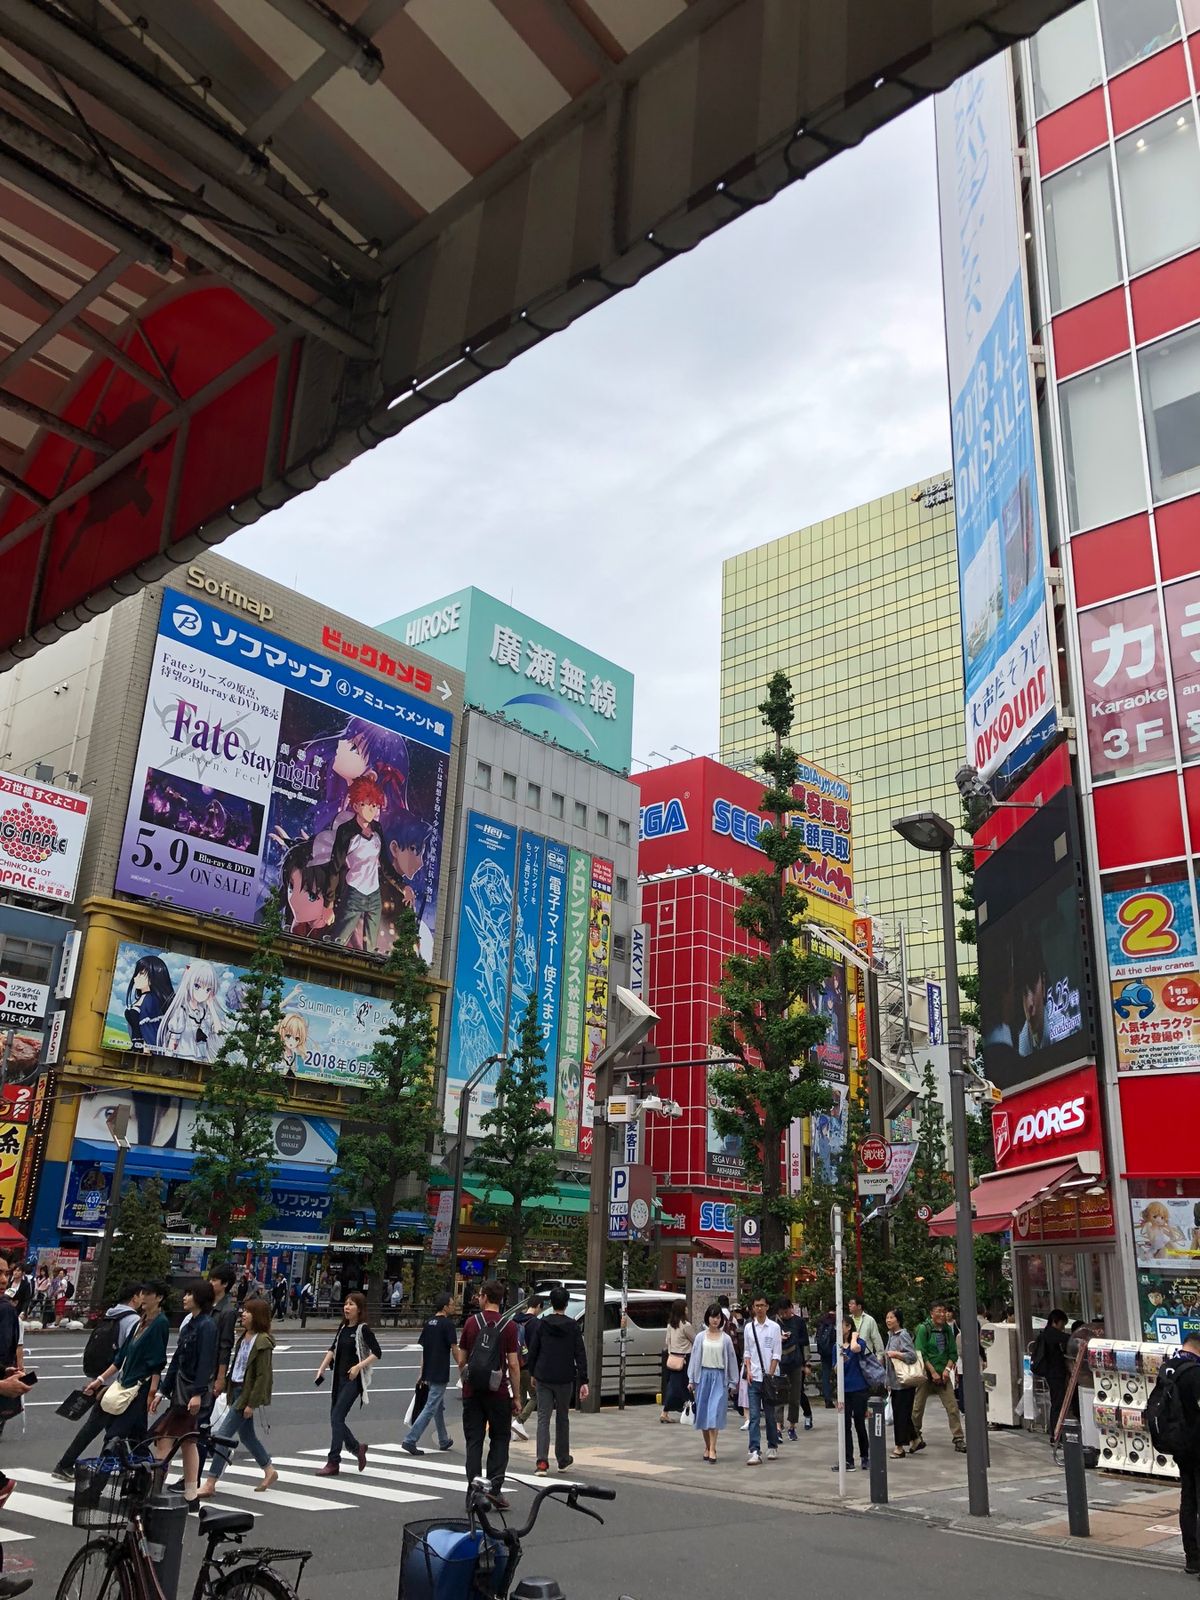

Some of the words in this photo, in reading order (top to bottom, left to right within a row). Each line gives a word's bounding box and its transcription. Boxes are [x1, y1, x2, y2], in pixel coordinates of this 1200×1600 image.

[958, 445, 980, 519] ON
[980, 355, 1026, 474] SALE
[186, 565, 274, 622] Sofmap
[405, 601, 462, 647] HIROSE
[210, 621, 332, 688] ソフマップ
[322, 625, 433, 694] ビックカメラ
[489, 623, 617, 720] 廣瀬無線
[1092, 688, 1169, 718] Karaoke
[1183, 683, 1200, 696] an
[169, 698, 240, 760] Fate
[1103, 718, 1164, 760] 3F
[241, 749, 276, 779] stay
[276, 758, 321, 791] night
[712, 798, 773, 854] SEG
[22, 829, 68, 855] APPLE
[131, 828, 189, 875] 5.9
[33, 868, 51, 877] SLOT
[198, 854, 225, 868] Blu-ray
[234, 864, 252, 876] DVD
[190, 867, 211, 887] ON
[214, 874, 252, 897] SALE
[1118, 892, 1180, 958] 2
[632, 928, 644, 978] AKKY
[1115, 968, 1126, 977] All
[1128, 966, 1142, 975] the
[1144, 964, 1162, 973] claw
[1165, 961, 1195, 971] cranes
[9, 991, 39, 1001] GPS専門店
[10, 984, 41, 996] リアルタイム
[7, 999, 37, 1013] next
[299, 995, 350, 1017] Summer
[49, 1021, 60, 1053] GPS
[1012, 1096, 1086, 1146] ADORES
[712, 1154, 726, 1164] SEGA
[863, 1148, 885, 1161] 消火栓
[613, 1170, 627, 1198] P
[275, 1208, 323, 1219] ミューズメント館
[276, 1192, 331, 1208] ソフマップ
[609, 1216, 620, 1231] IN
[699, 1201, 736, 1232] SEG
